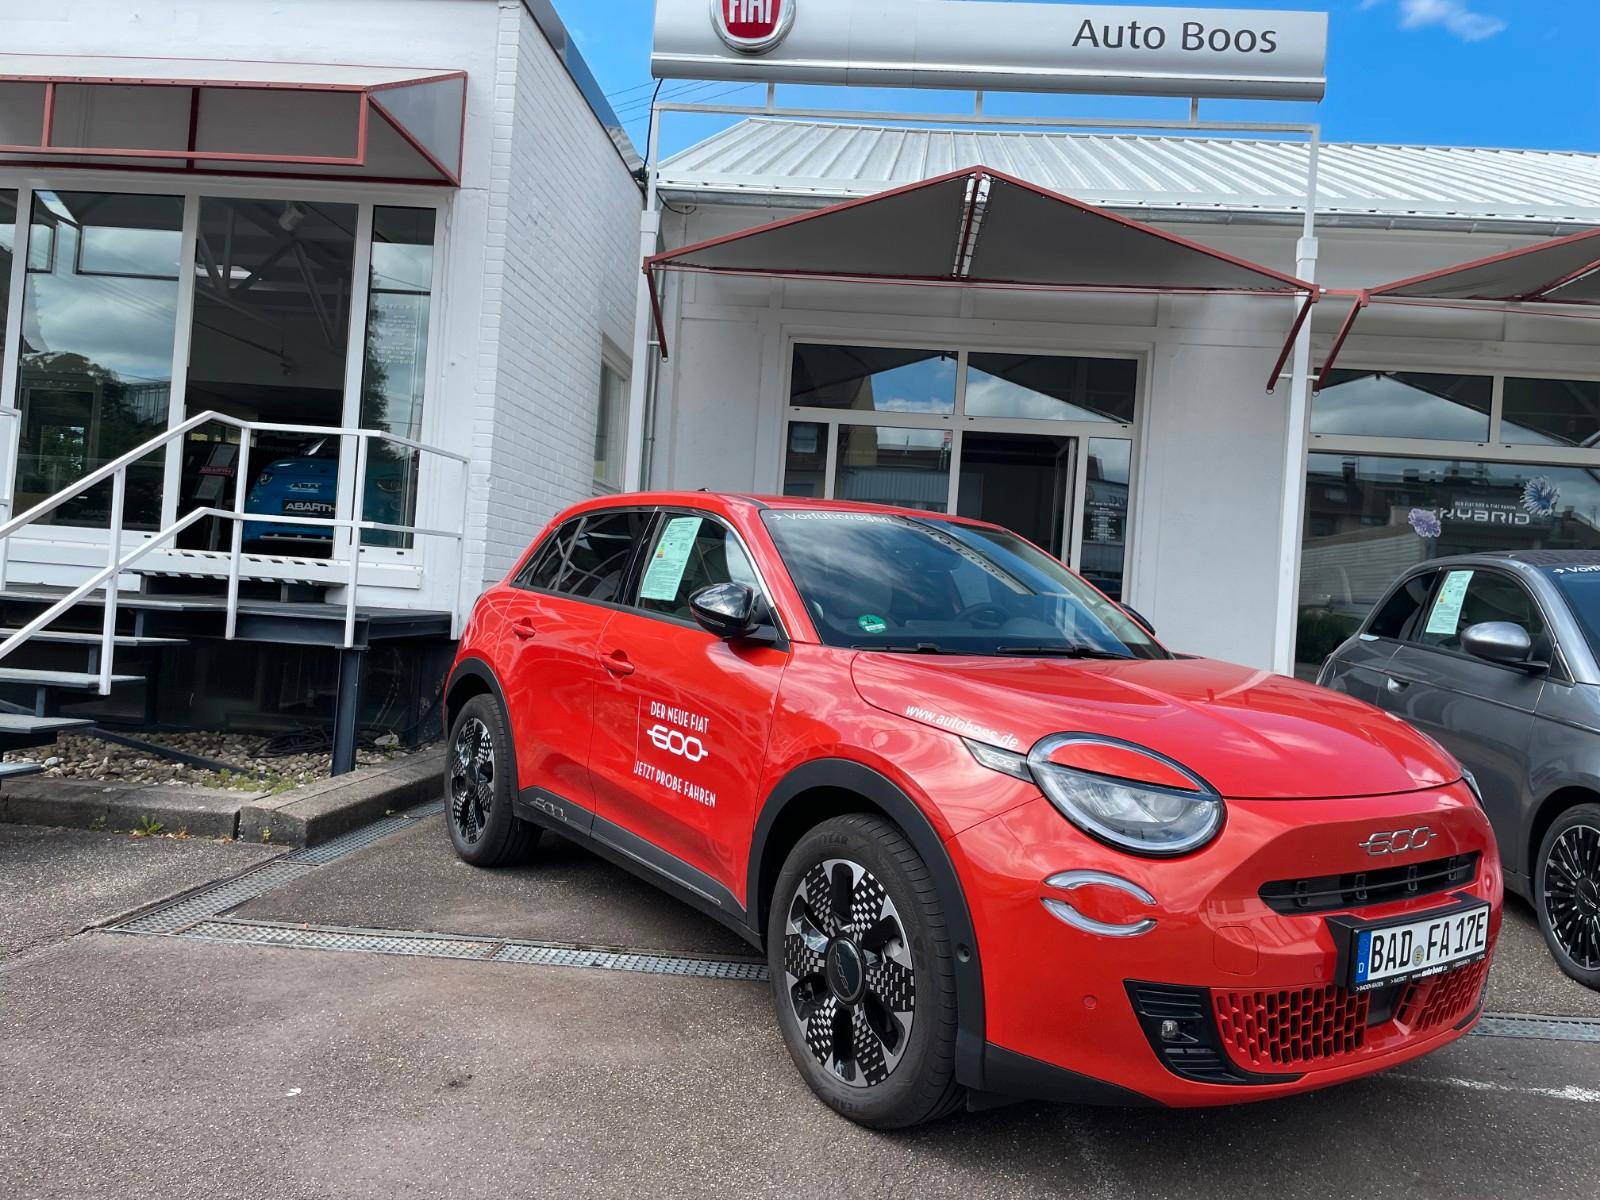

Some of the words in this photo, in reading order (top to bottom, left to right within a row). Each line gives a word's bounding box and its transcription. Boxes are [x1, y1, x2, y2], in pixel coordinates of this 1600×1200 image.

[1071, 19, 1166, 50] Auto
[1181, 21, 1277, 54] Boos
[286, 502, 335, 512] ABARTH
[783, 512, 892, 523] Vorführwagen
[650, 701, 666, 719] DER
[667, 707, 689, 727] NEUE
[690, 713, 709, 734] FIAT
[905, 704, 1019, 748] www.autoboos.de
[646, 724, 709, 762] 600
[633, 761, 655, 780] JETZT
[656, 769, 682, 793] PROBE
[684, 782, 716, 808] FAHREN
[1358, 826, 1439, 857] 600
[1370, 930, 1412, 974] BAD
[1426, 921, 1450, 961] FA
[1454, 911, 1486, 954] 17E
[1358, 962, 1365, 973] D
